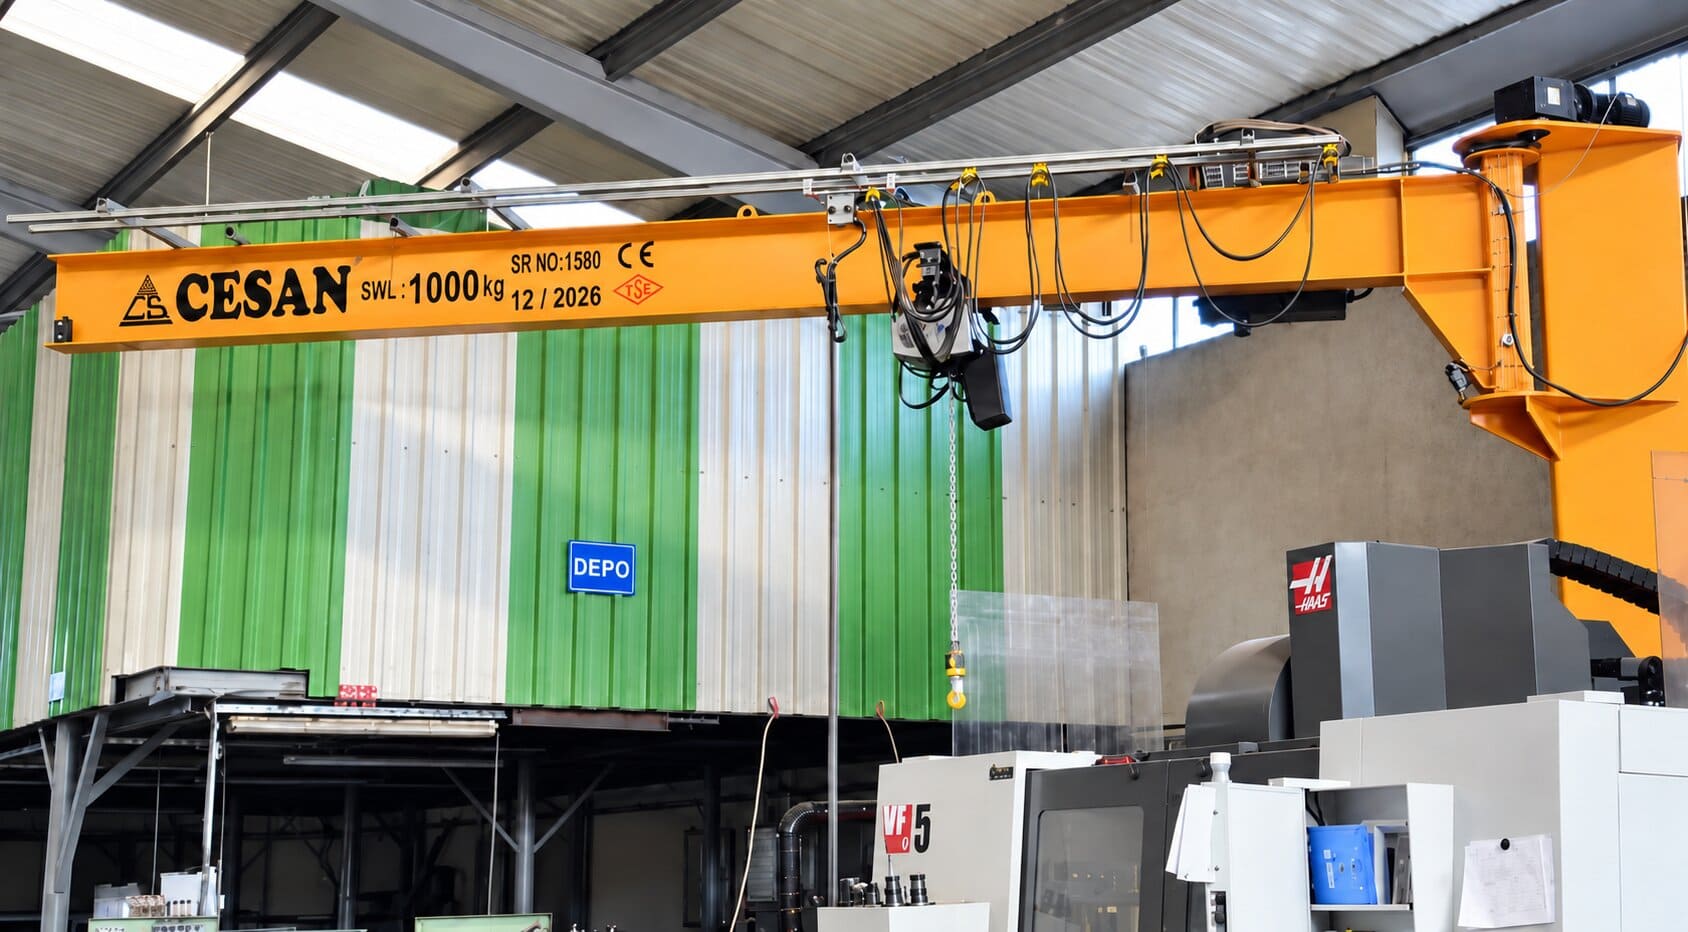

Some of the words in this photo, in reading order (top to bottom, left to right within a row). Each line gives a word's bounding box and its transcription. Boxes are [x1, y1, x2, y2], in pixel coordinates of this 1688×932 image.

[511, 254, 531, 274] SR
[536, 250, 601, 273] NO:1580
[618, 240, 654, 269] CE
[176, 265, 351, 322] CESAN
[409, 269, 479, 304] 1000
[483, 274, 504, 302] kg
[511, 288, 534, 311] 12
[553, 285, 602, 308] 2026
[625, 279, 651, 299] TSE
[574, 557, 630, 579] DEPO
[1295, 592, 1331, 612] HAAS
[883, 805, 907, 836] VF
[914, 803, 931, 854] 5
